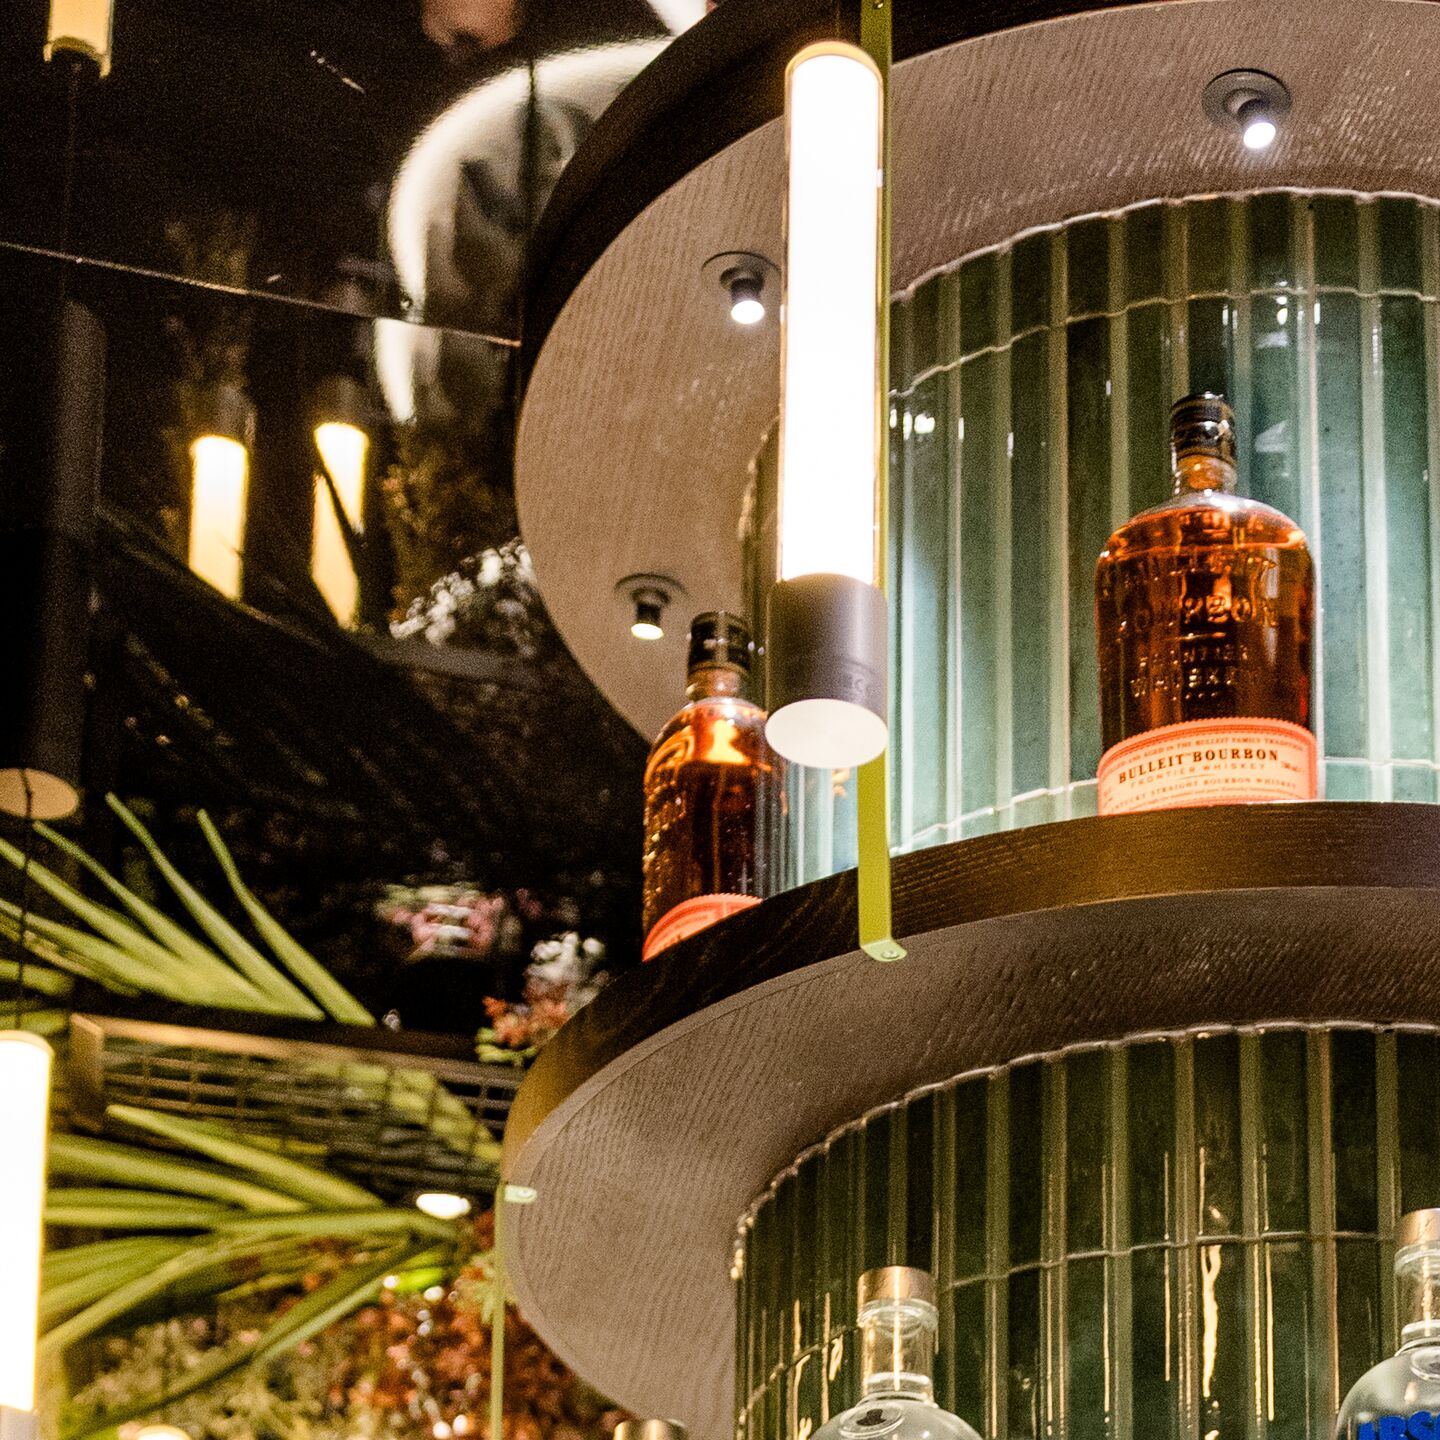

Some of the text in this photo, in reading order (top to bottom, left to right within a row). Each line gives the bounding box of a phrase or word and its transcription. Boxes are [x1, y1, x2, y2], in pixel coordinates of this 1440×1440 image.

[1119, 748, 1280, 784] BULLEIT BOURBON
[1130, 766, 1197, 789] FRONTIER
[1202, 762, 1266, 771] WHISKEY
